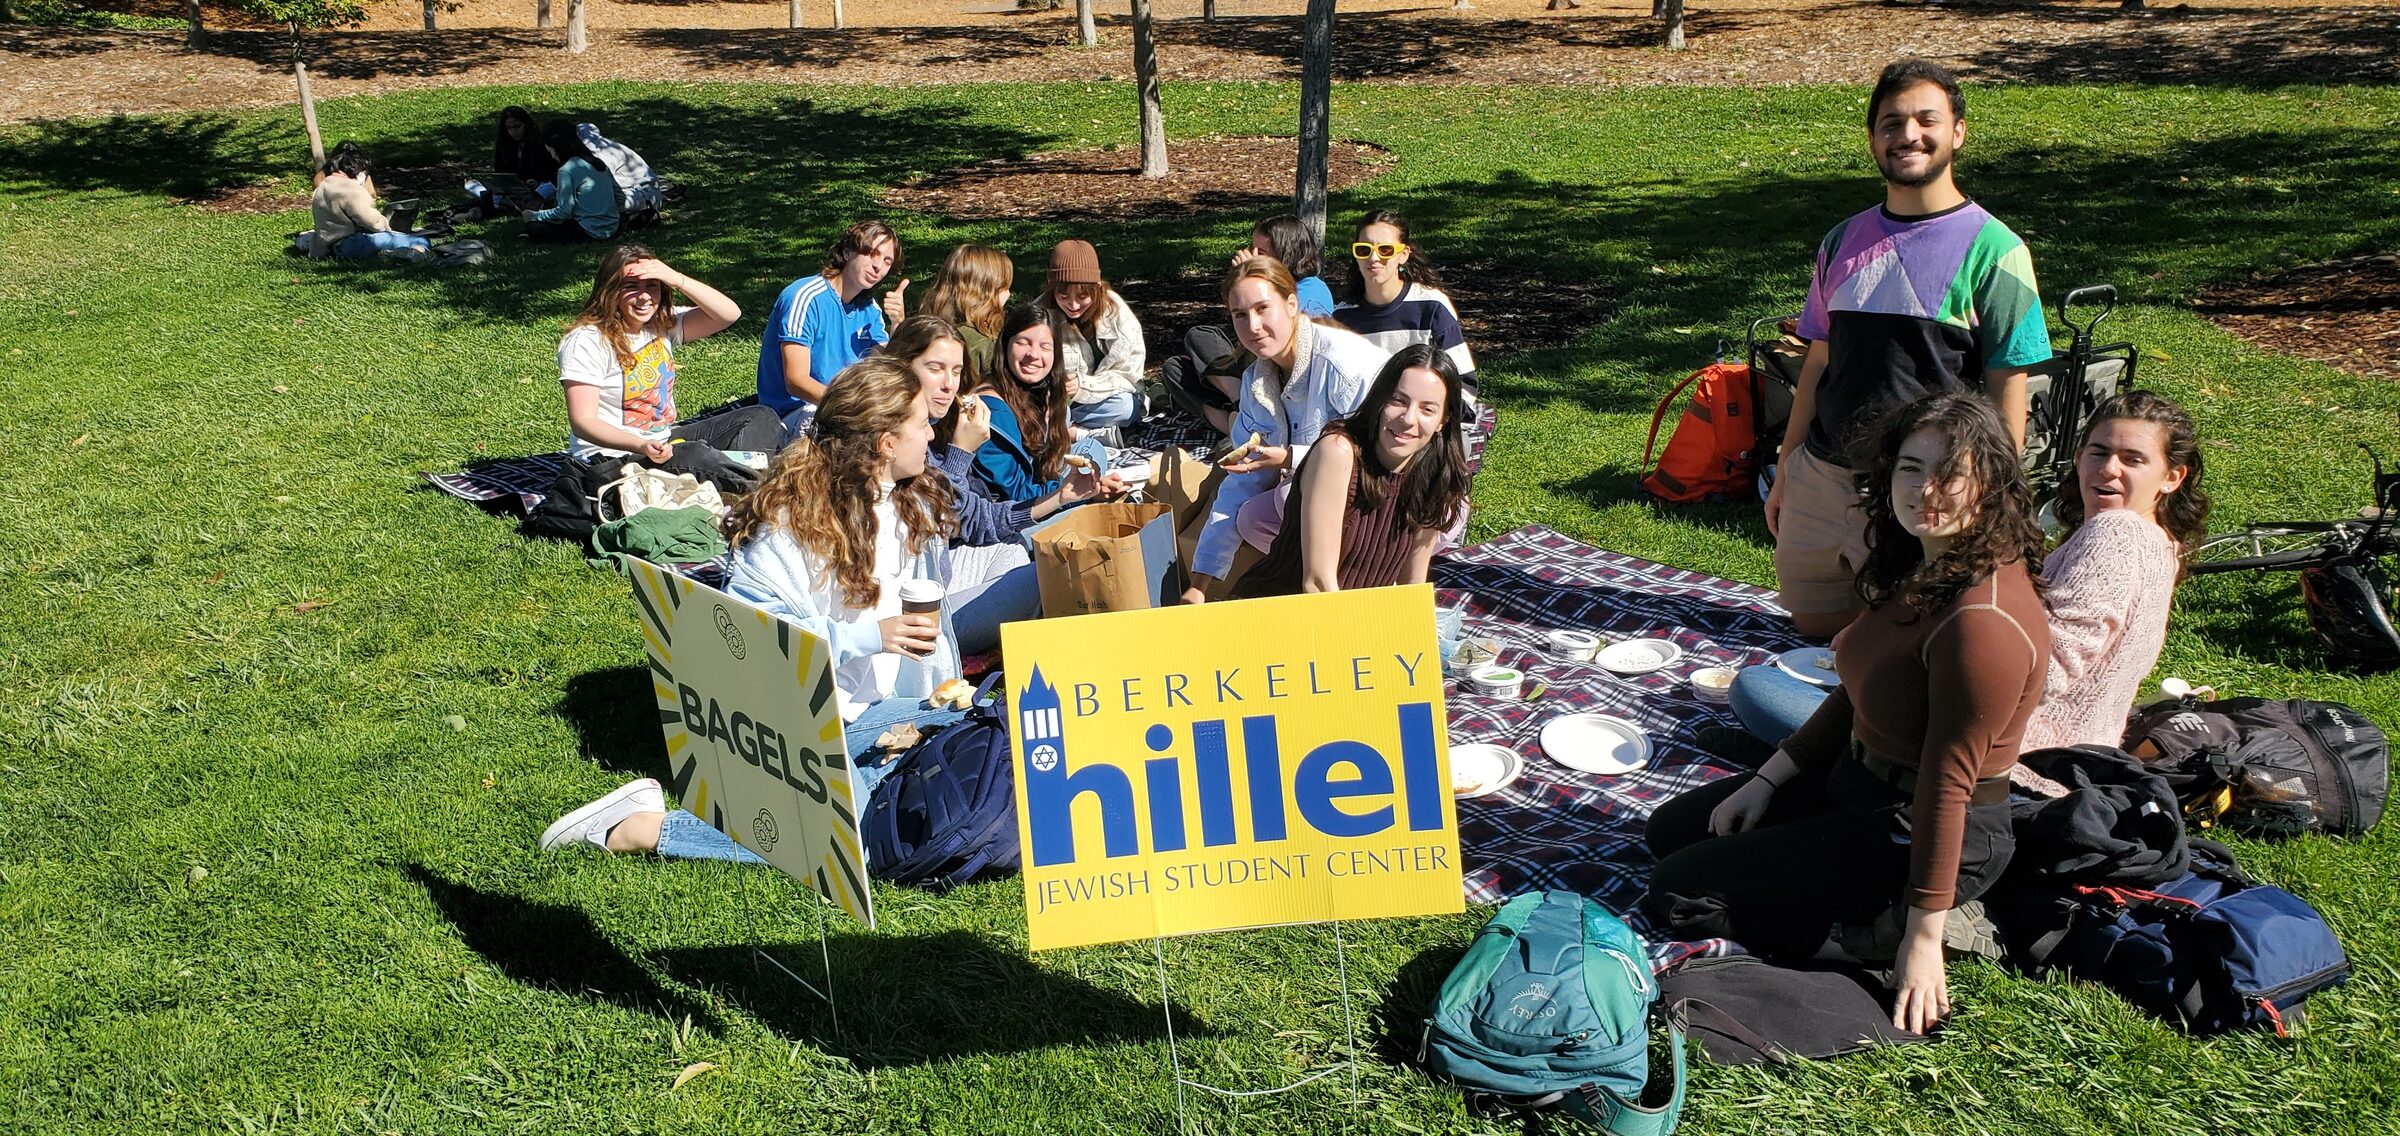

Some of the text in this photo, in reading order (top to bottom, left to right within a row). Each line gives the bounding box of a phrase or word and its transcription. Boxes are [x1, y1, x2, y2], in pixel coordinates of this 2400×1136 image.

[1075, 652, 1424, 718] BERKELEY
[678, 682, 828, 804] BAGELS
[1018, 661, 1444, 867] hillel
[1038, 845, 1450, 914] JEWISH STUDENT CENTER
[1508, 1005, 1556, 1020] OSREY
